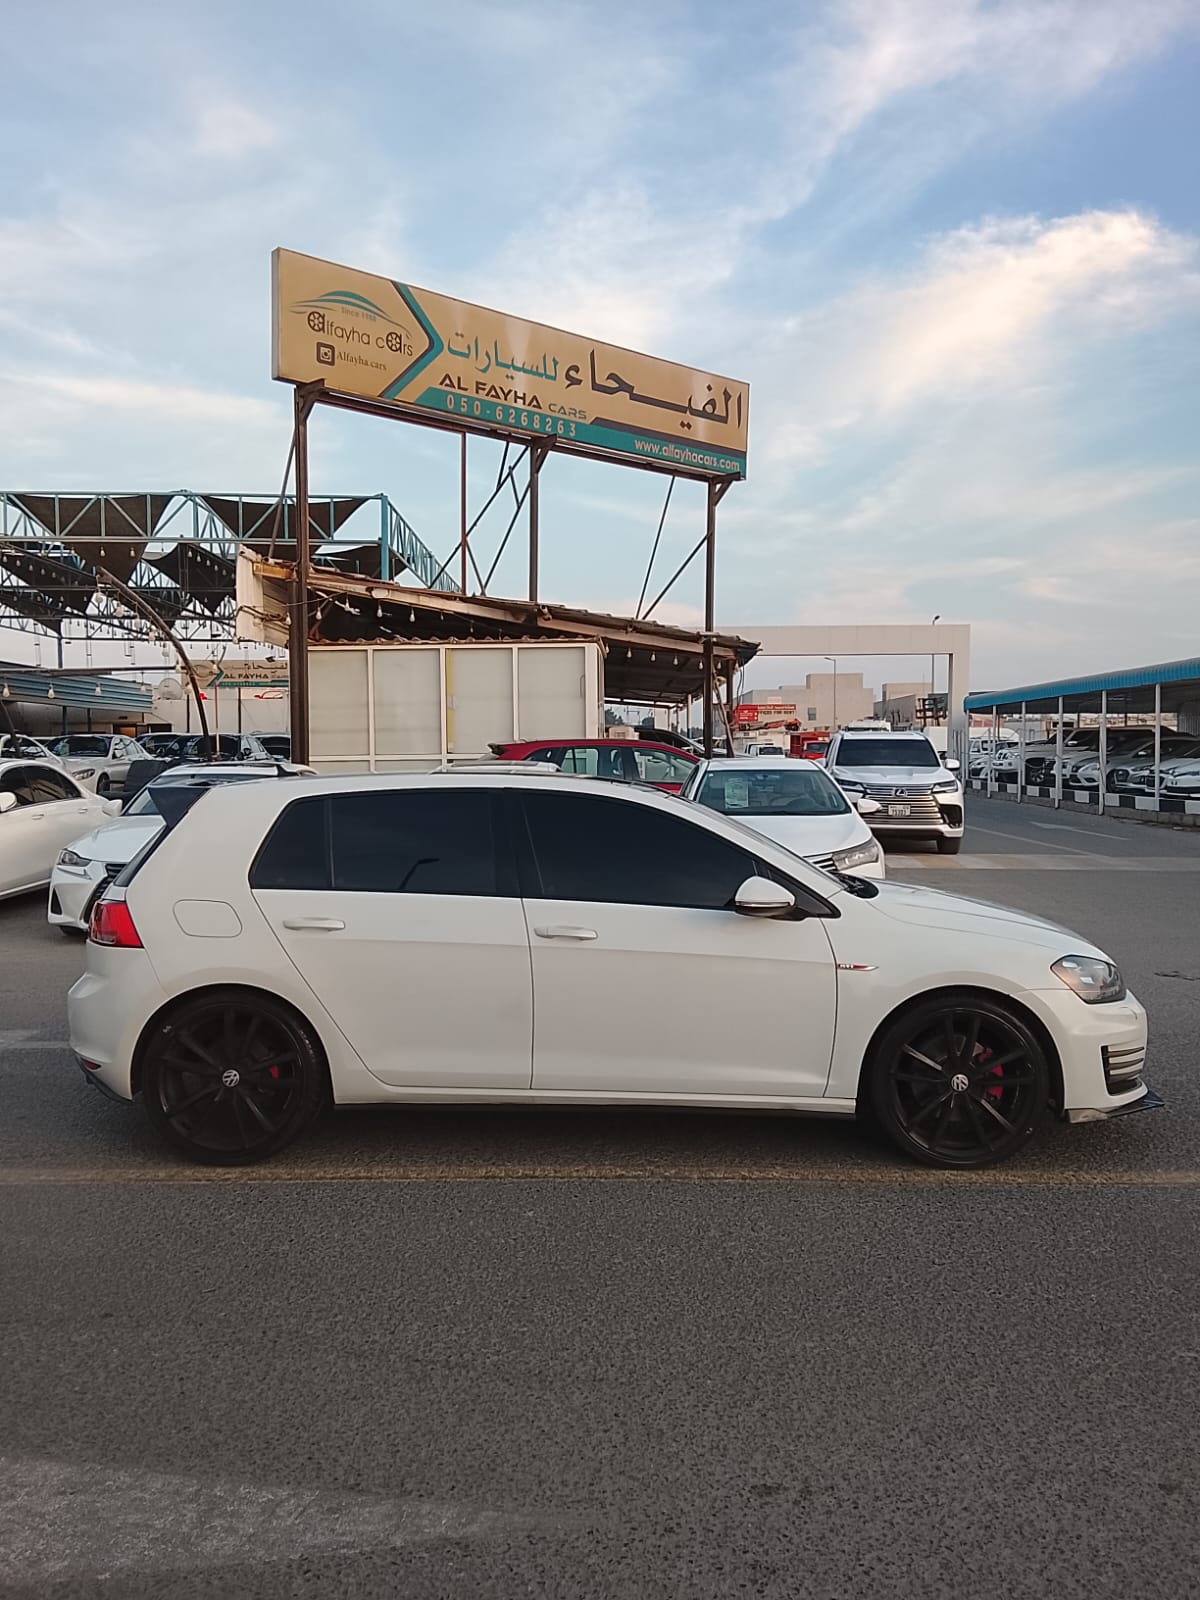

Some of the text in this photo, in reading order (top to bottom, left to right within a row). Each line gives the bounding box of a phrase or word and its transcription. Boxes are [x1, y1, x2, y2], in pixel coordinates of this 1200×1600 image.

[307, 311, 413, 357] alfayha cars
[446, 331, 558, 382] للسيارات
[439, 373, 587, 419] AL FAYHA CARS
[446, 394, 576, 437] 050-6268263
[634, 439, 741, 472] www.alfayhacars.com
